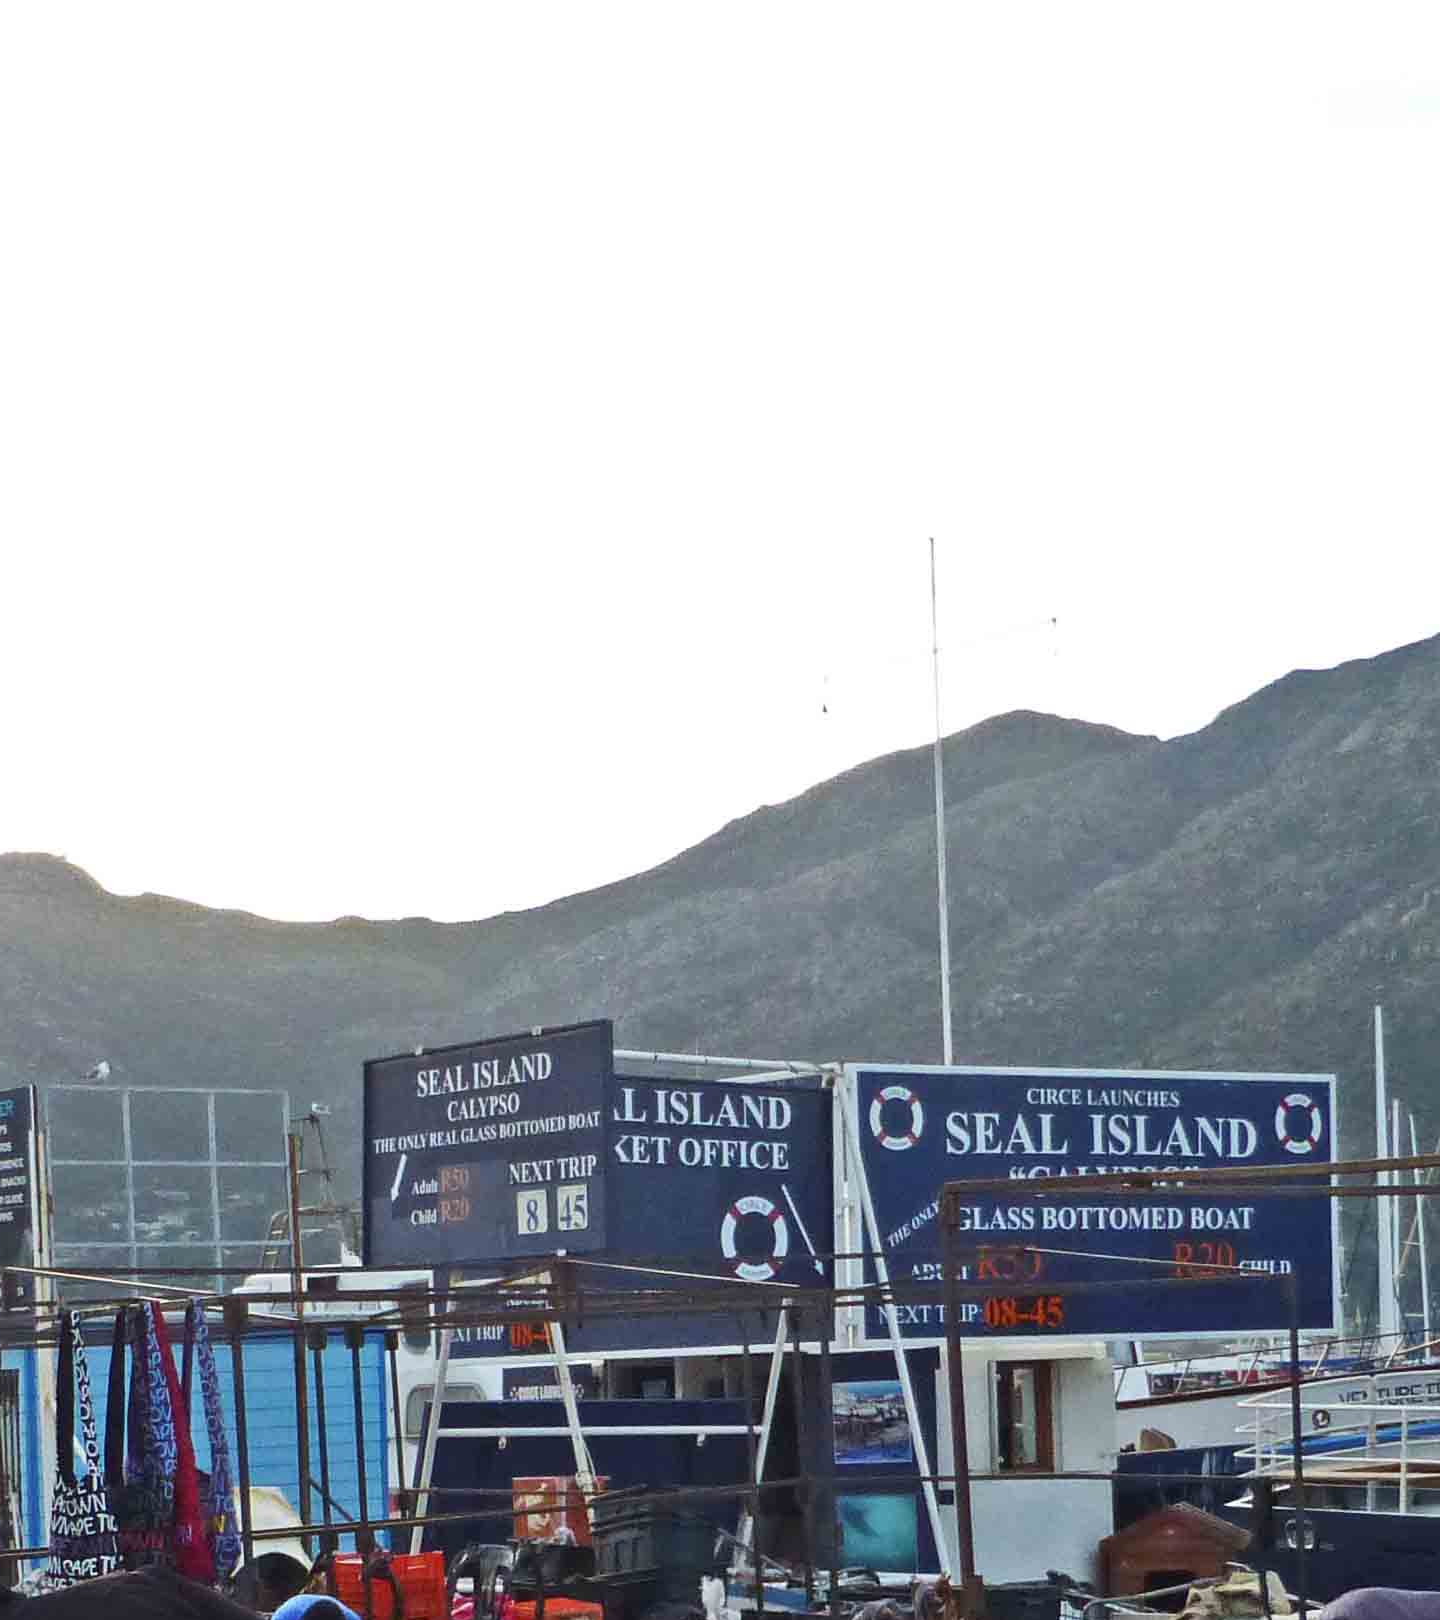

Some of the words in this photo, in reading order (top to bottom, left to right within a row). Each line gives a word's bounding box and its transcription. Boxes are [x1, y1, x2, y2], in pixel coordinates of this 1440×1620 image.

[416, 1066, 468, 1097] SEAL
[472, 1052, 552, 1088] ISLAND
[447, 1092, 520, 1123] CALYPSO
[654, 1090, 792, 1130] ISLAND
[1026, 1088, 1082, 1106] CIRCE
[1087, 1089, 1180, 1108] LAUNCHES
[373, 1137, 396, 1154] THE
[397, 1132, 428, 1153] ONLY
[429, 1128, 460, 1147] REAL
[461, 1124, 496, 1143] GLASS
[498, 1115, 566, 1139] BOTTOMED
[568, 1110, 599, 1131] BOAT
[945, 1111, 1068, 1156] SEAL
[1089, 1113, 1257, 1158] ISLAND
[678, 1137, 790, 1170] OFFICE
[509, 1160, 553, 1184] NEXT
[557, 1155, 597, 1179] TRIP
[411, 1180, 438, 1196] Adult
[410, 1208, 437, 1225] Child
[525, 1199, 539, 1232] 8
[559, 1194, 586, 1229] 45
[960, 1207, 1034, 1230] GLASS
[1042, 1206, 1183, 1231] BOTTOMED
[1191, 1206, 1254, 1231] BOAT
[886, 1227, 911, 1248] THE
[985, 1296, 1064, 1328] 08-45
